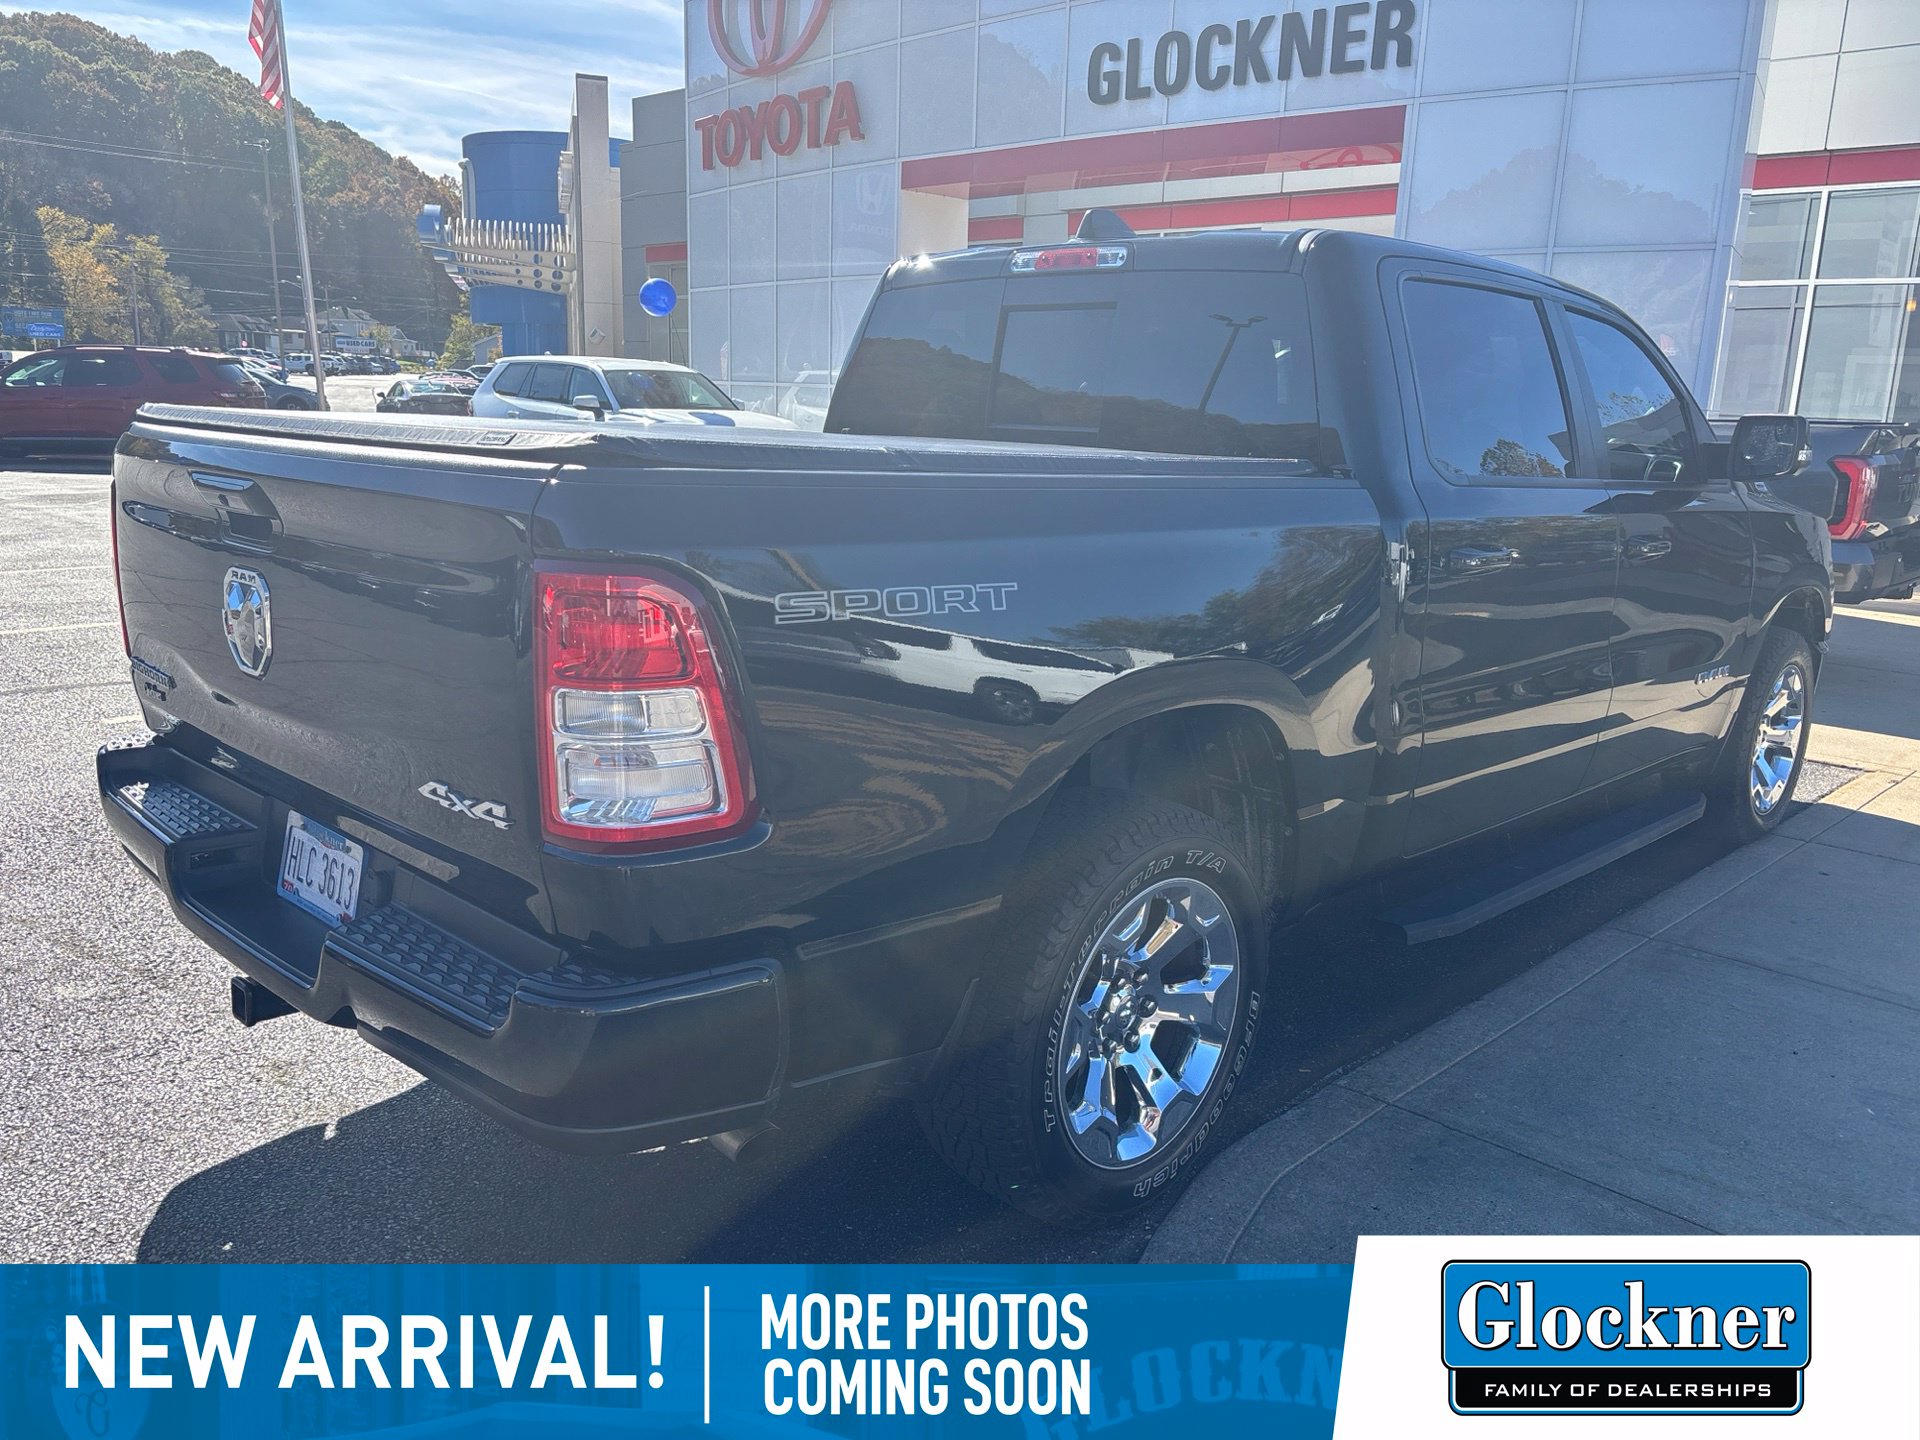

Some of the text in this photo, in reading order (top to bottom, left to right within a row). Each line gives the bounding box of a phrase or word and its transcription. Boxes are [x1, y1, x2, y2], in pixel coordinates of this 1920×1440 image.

[1087, 0, 1416, 106] GLOCKNER
[695, 80, 865, 171] TOYOTA
[231, 570, 256, 584] RAM
[775, 582, 1018, 625] SPORT
[287, 836, 317, 887] HLC
[318, 852, 355, 910] 3613
[1186, 850, 1227, 874] T/A
